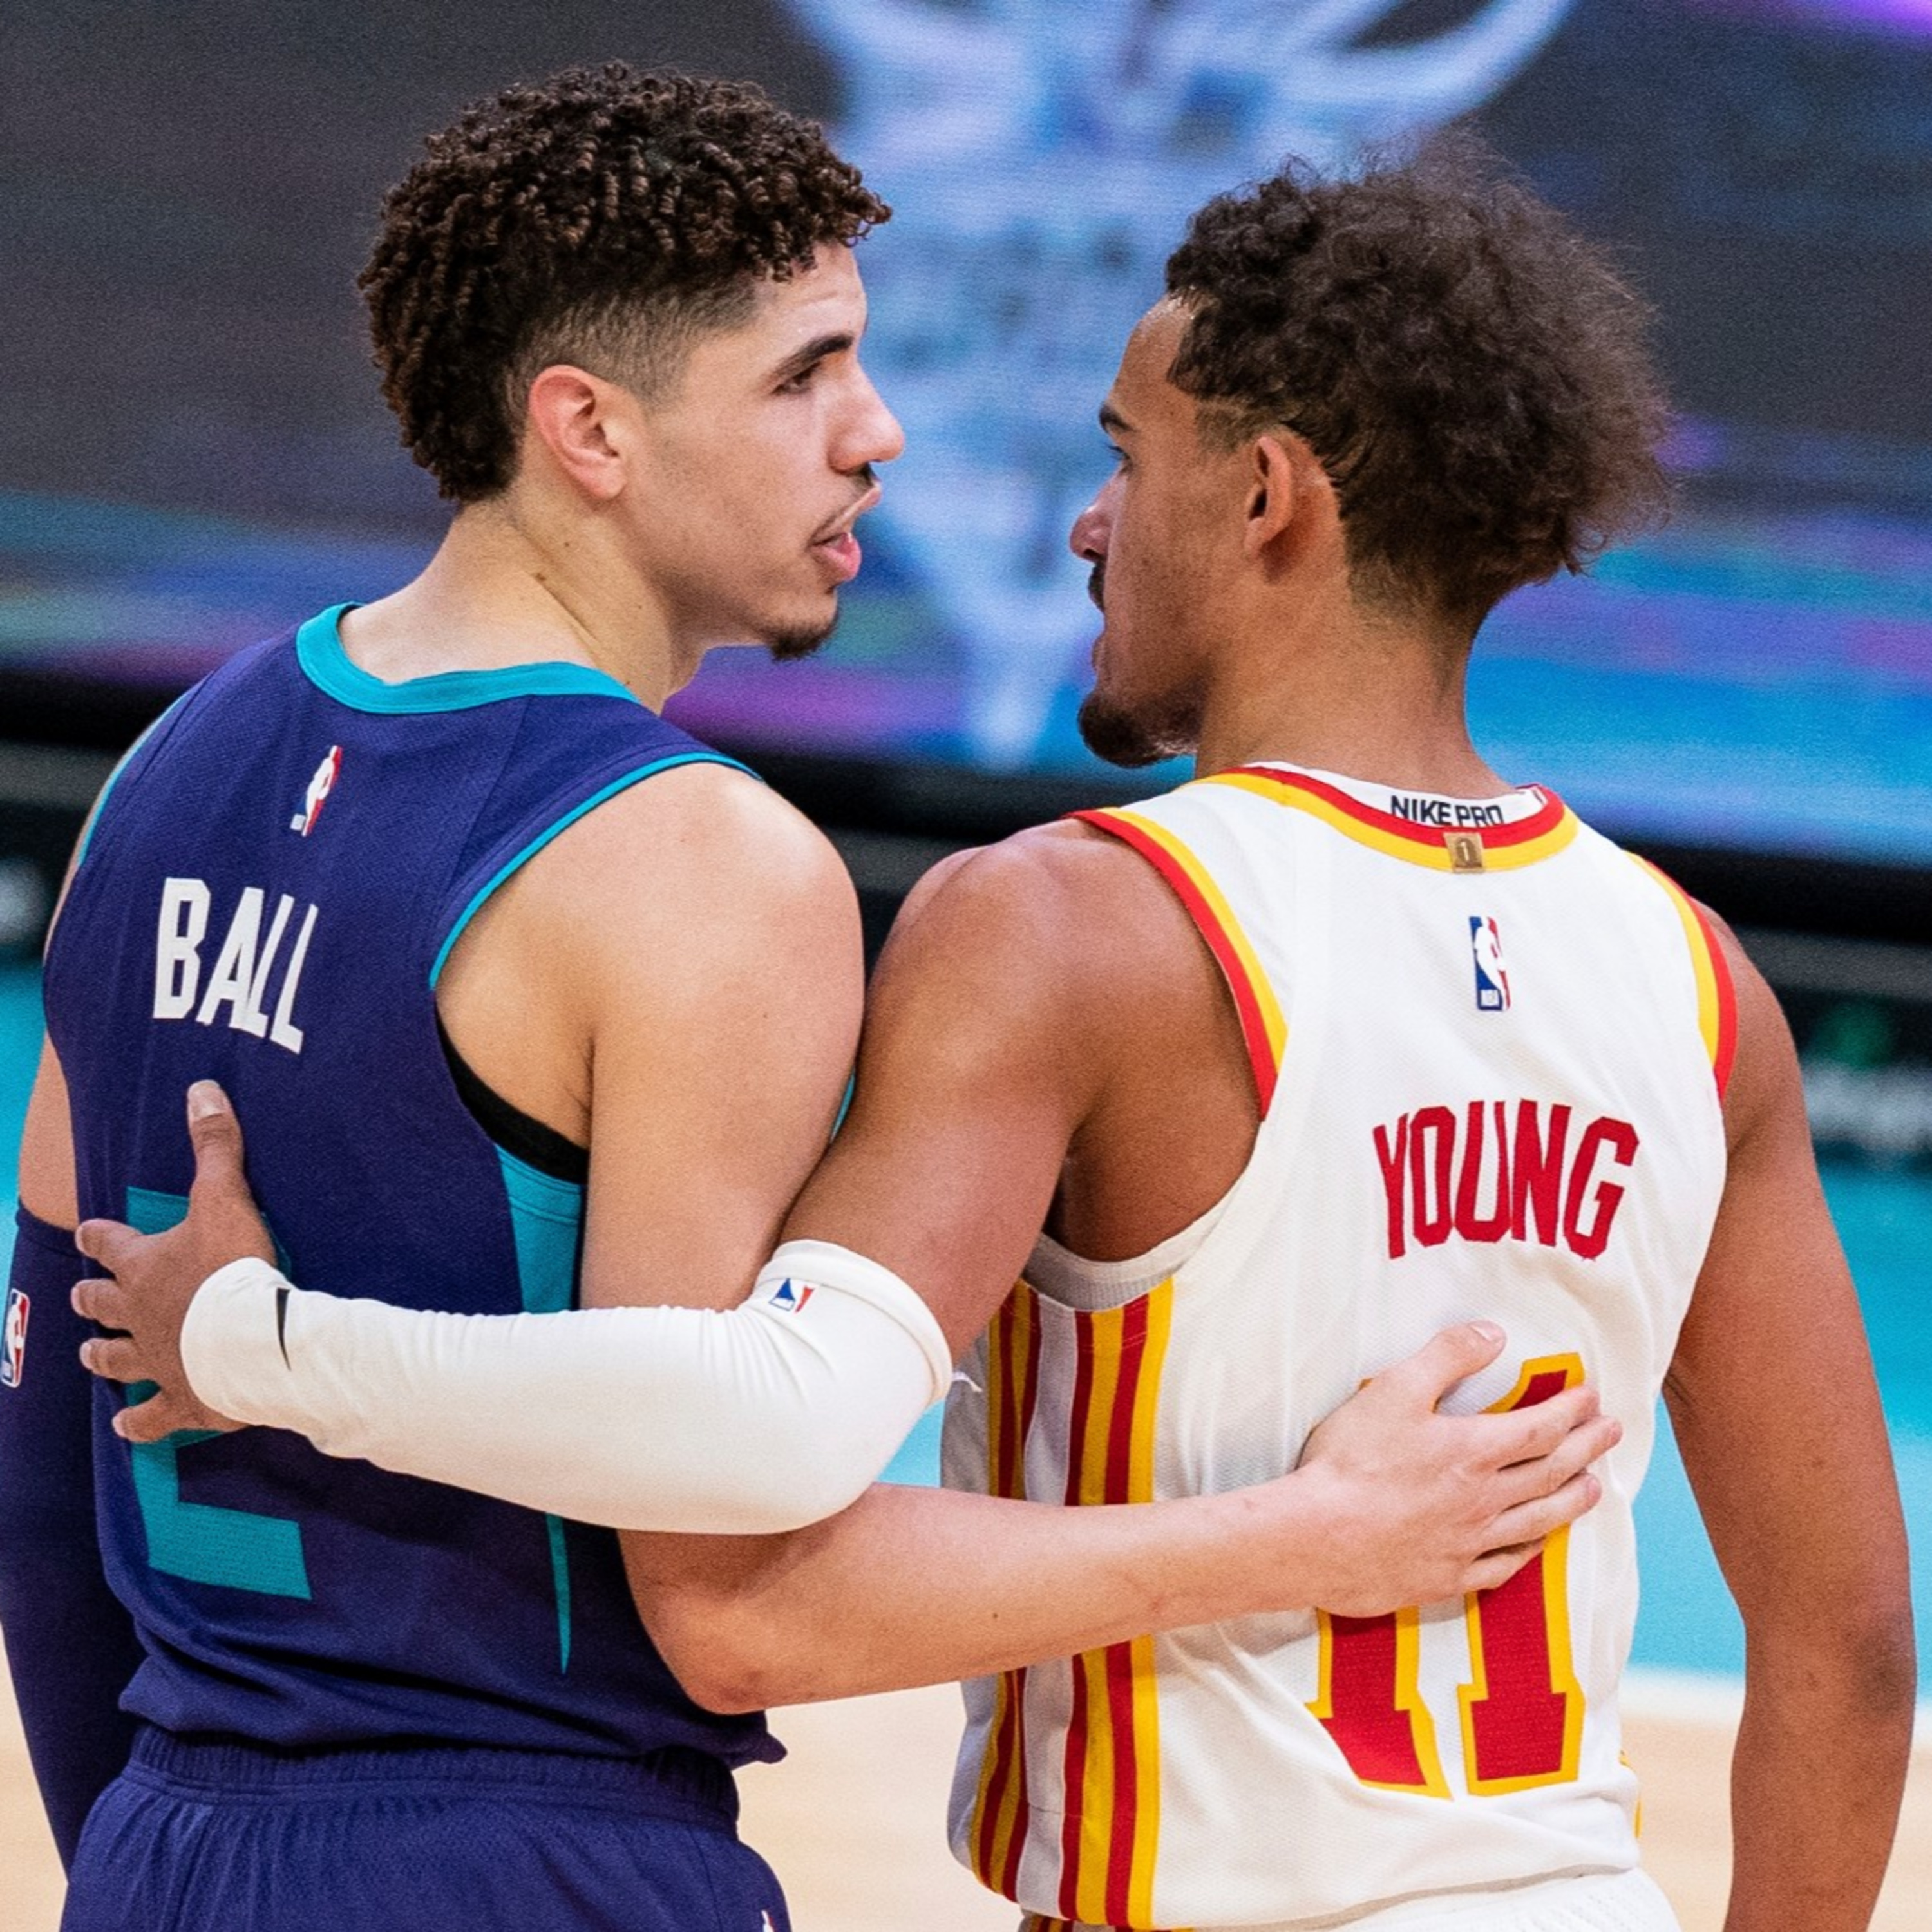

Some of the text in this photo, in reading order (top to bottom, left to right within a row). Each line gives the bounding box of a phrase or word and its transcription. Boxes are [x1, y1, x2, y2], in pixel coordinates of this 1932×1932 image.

[1391, 795, 1504, 826] NIKE PRO
[153, 877, 318, 1054] BALL
[1372, 1098, 1640, 1260] YOUNG
